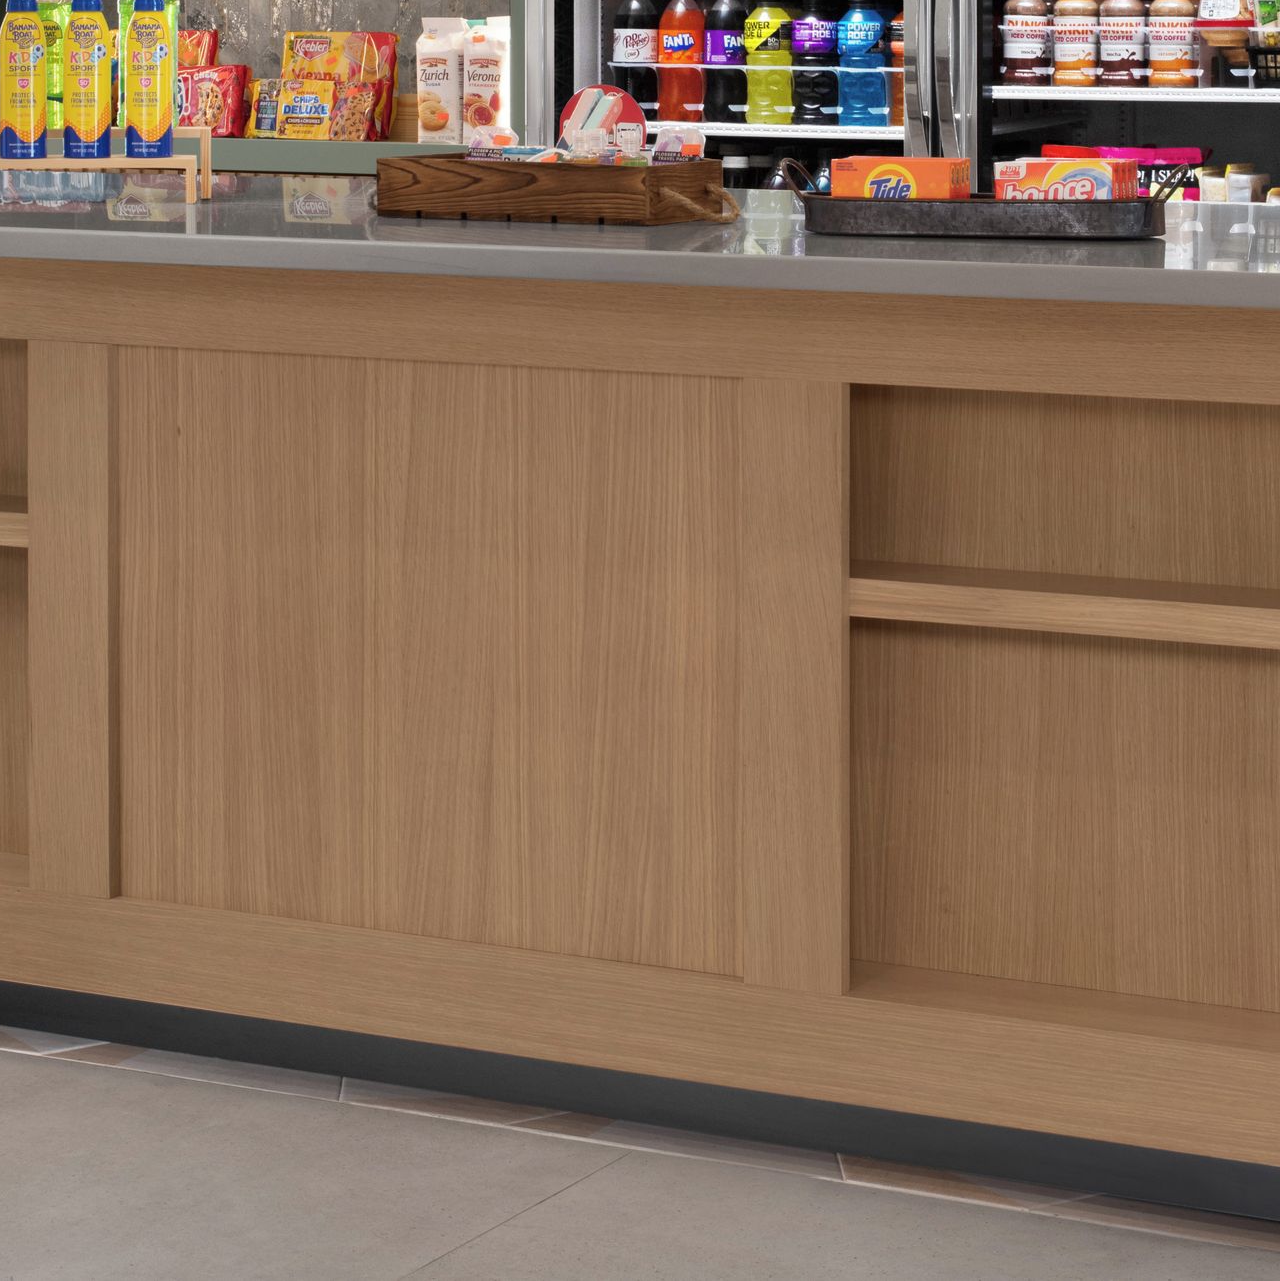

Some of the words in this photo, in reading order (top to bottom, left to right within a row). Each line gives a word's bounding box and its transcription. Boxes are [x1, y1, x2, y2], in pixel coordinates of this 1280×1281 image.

[8, 21, 37, 31] BANANA
[70, 21, 99, 31] BANANA
[133, 21, 161, 30] BANANA
[847, 23, 880, 31] POWER
[13, 30, 32, 40] BOAT
[74, 30, 94, 40] BOAT
[136, 30, 156, 40] BOAT
[295, 39, 331, 55] Keebler
[663, 33, 695, 51] FANTA
[420, 69, 449, 82] Zurich
[467, 70, 501, 82] Verona
[293, 95, 320, 104] CHIPS
[283, 103, 328, 115] DELUXE
[869, 178, 911, 198] Tide
[1004, 178, 1095, 200] bounce
